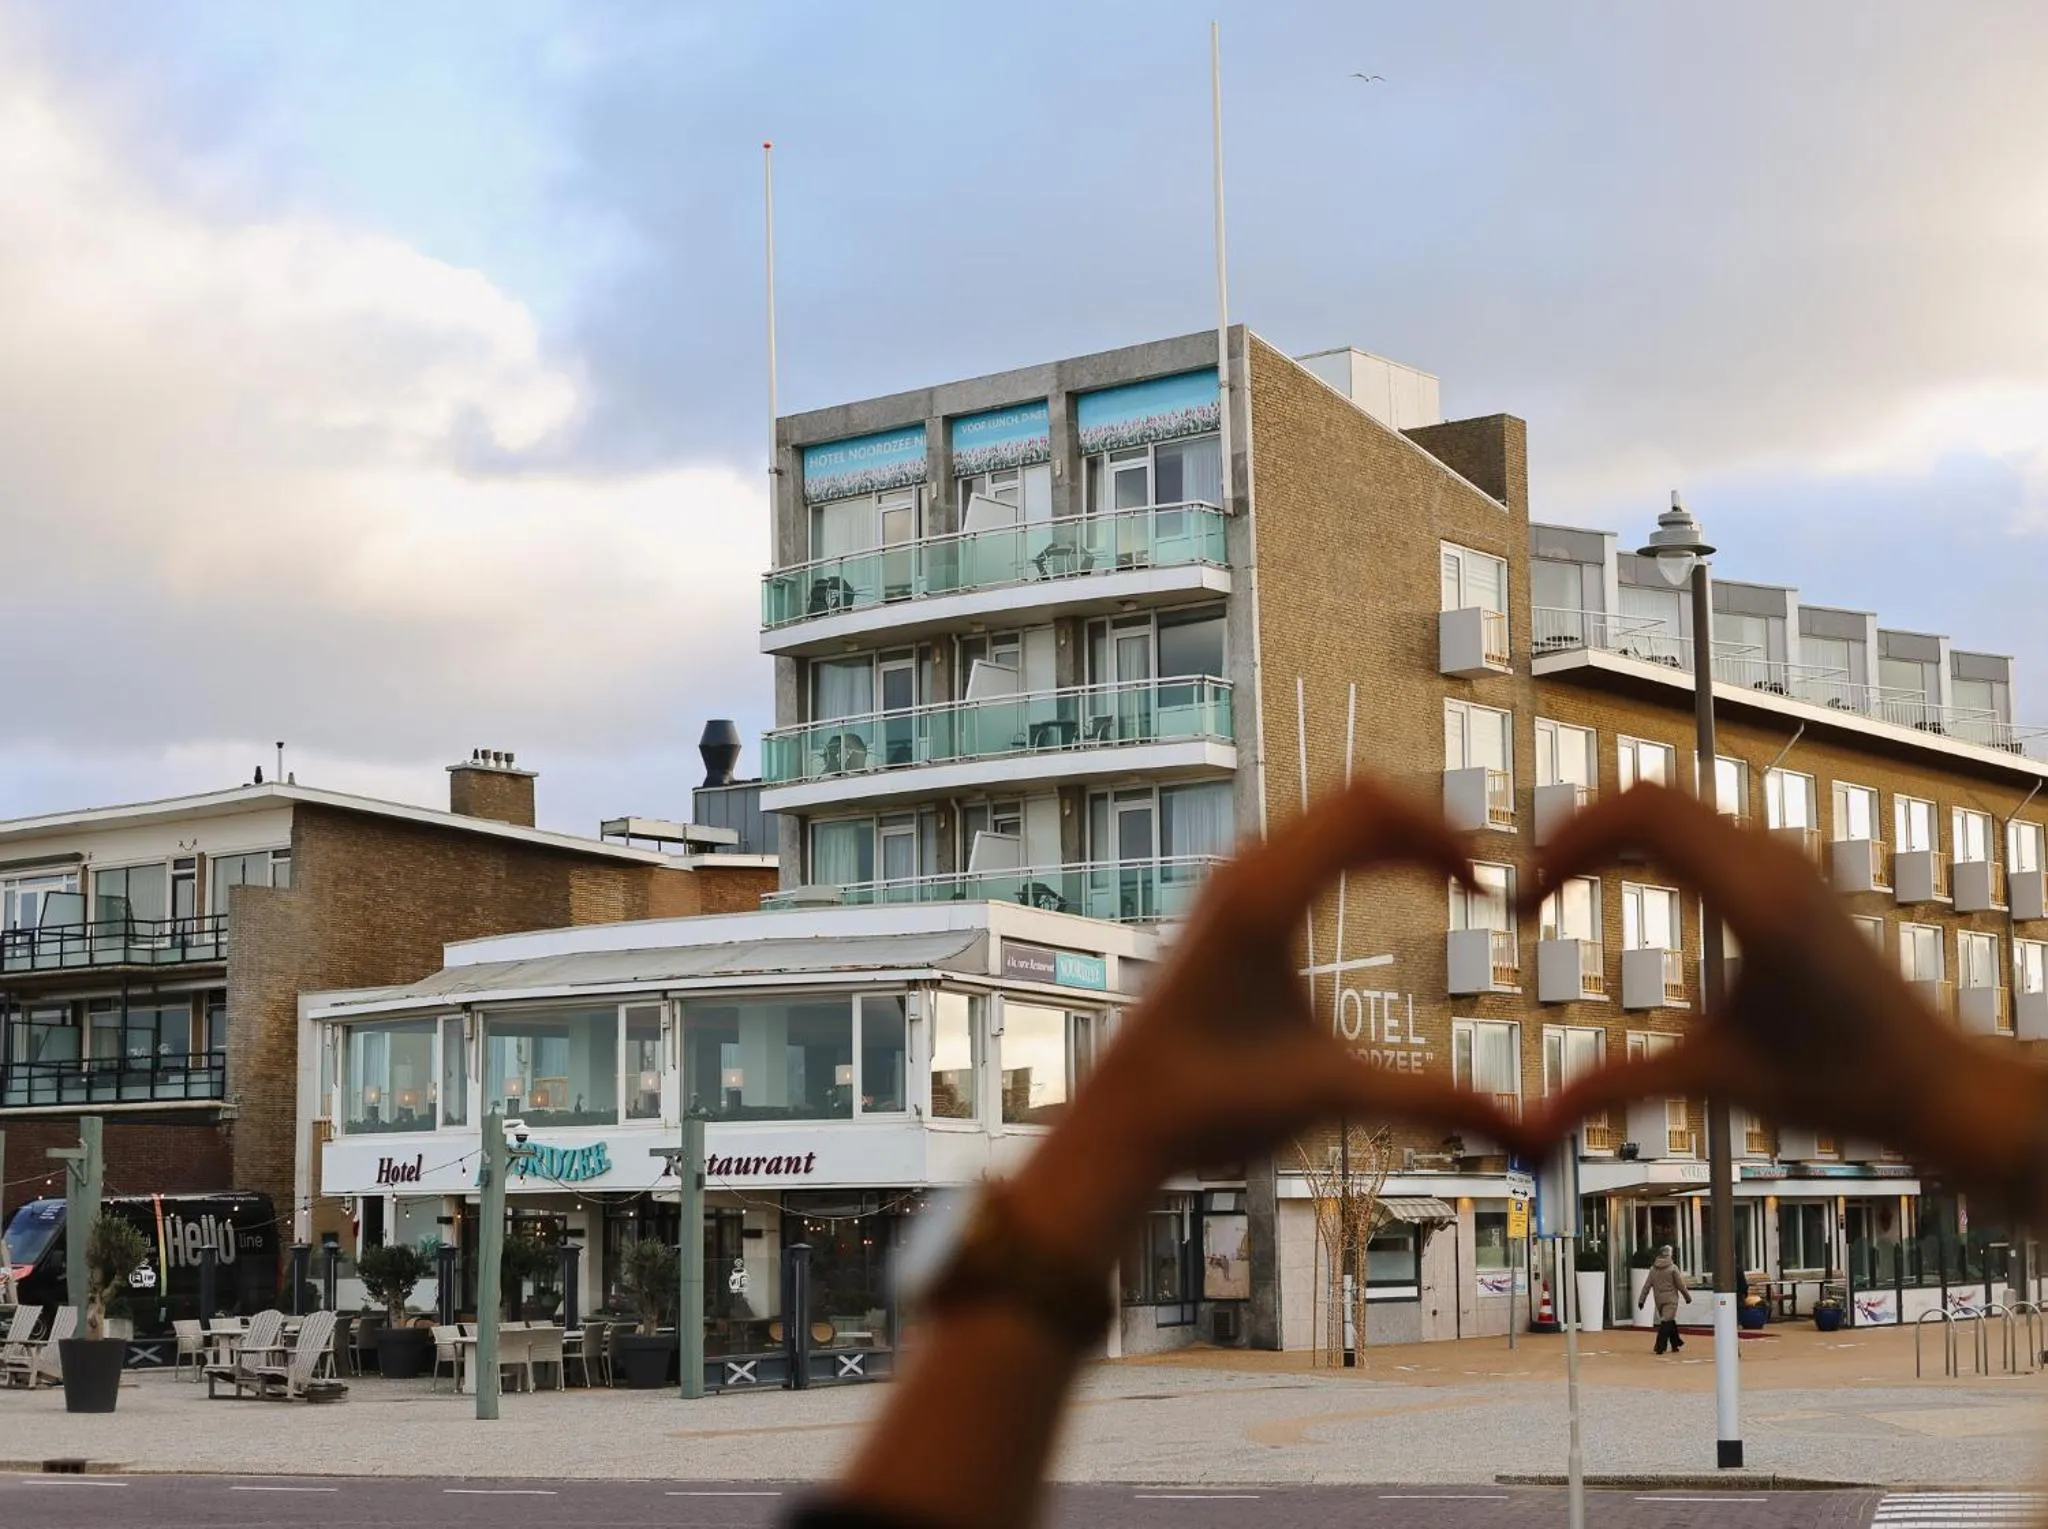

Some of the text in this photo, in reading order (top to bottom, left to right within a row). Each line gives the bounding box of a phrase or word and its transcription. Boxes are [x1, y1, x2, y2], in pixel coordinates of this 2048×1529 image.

[808, 450, 847, 469] HOTEL
[376, 1153, 423, 1184] Hotel
[165, 1214, 264, 1268] Hello line
